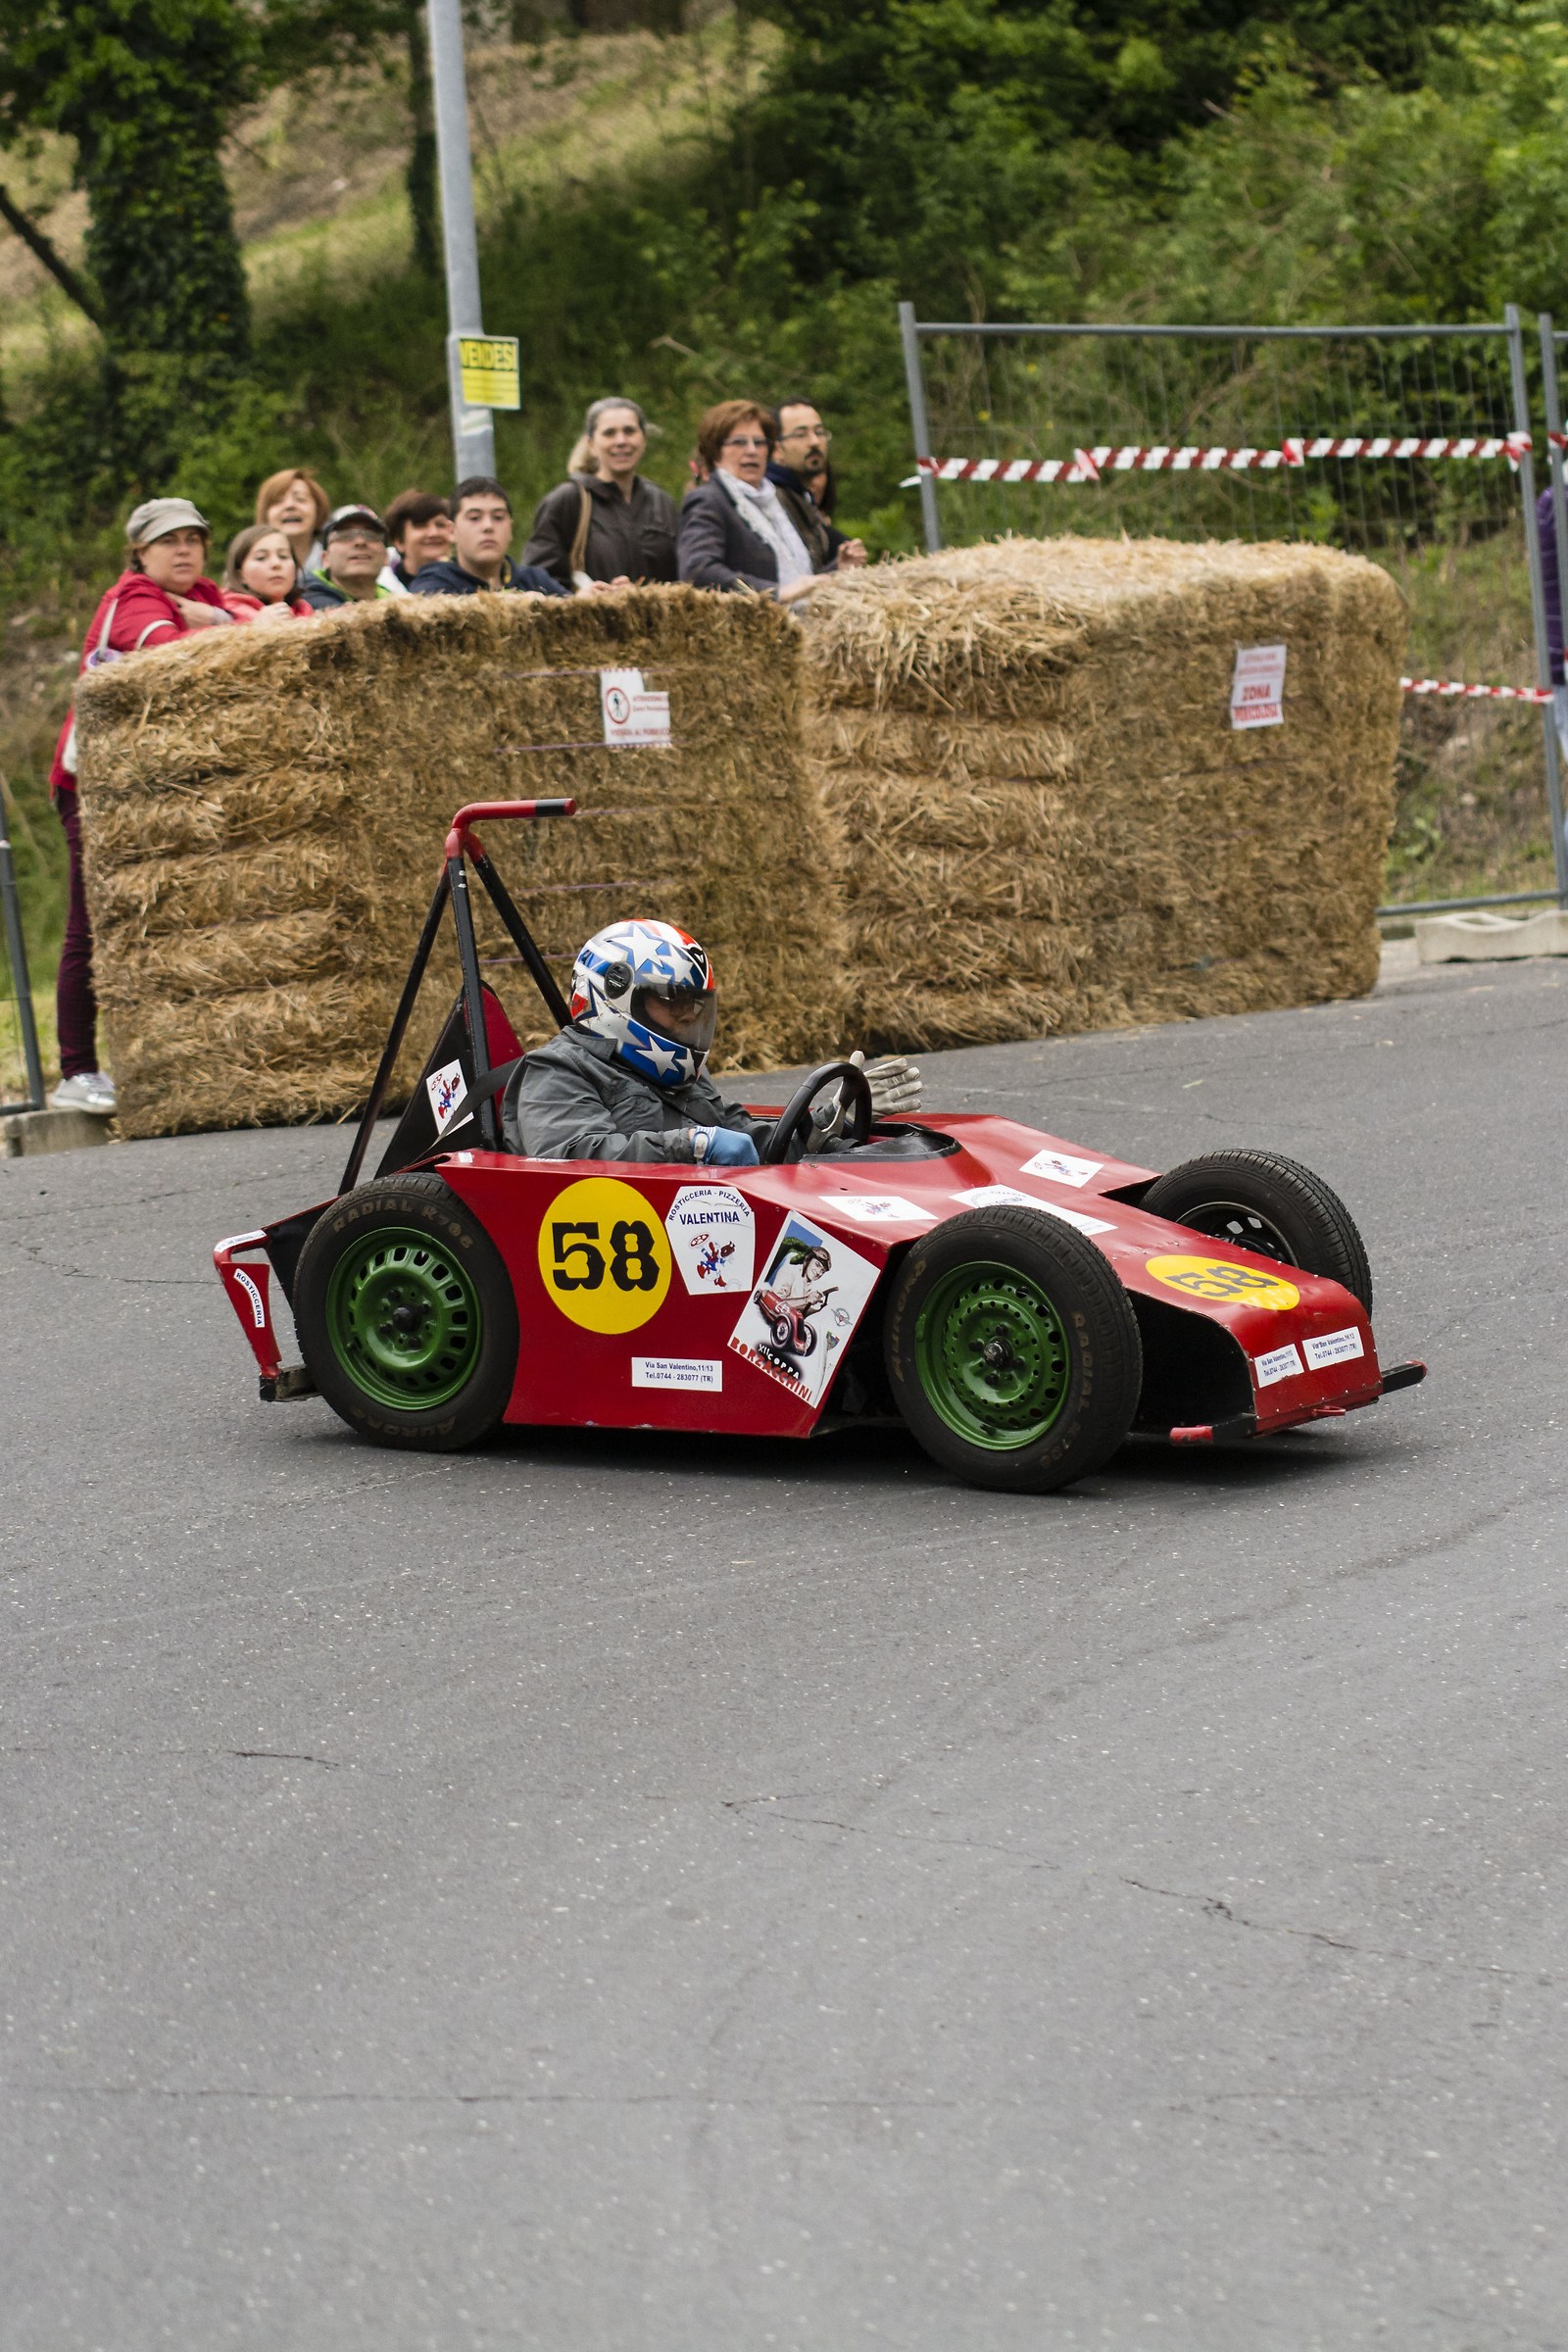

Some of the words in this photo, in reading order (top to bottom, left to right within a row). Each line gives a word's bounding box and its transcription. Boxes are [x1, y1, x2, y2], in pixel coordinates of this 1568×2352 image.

[460, 339, 518, 371] VENDESI
[1242, 684, 1271, 701] ZONA
[333, 1199, 413, 1233] RADIAL
[669, 1190, 712, 1221] ROSTICCERIA
[718, 1190, 750, 1217] PIZZERIA
[679, 1211, 740, 1225] VALENTINA
[552, 1220, 661, 1292] 58
[1164, 1266, 1280, 1298] 58
[235, 1272, 263, 1325] ROSTICCERIA
[730, 1336, 813, 1401] BORZACCHINI
[758, 1343, 771, 1356] XII
[767, 1352, 801, 1380] COPPA
[676, 1373, 699, 1382] 283077
[700, 1375, 713, 1384] (TR)
